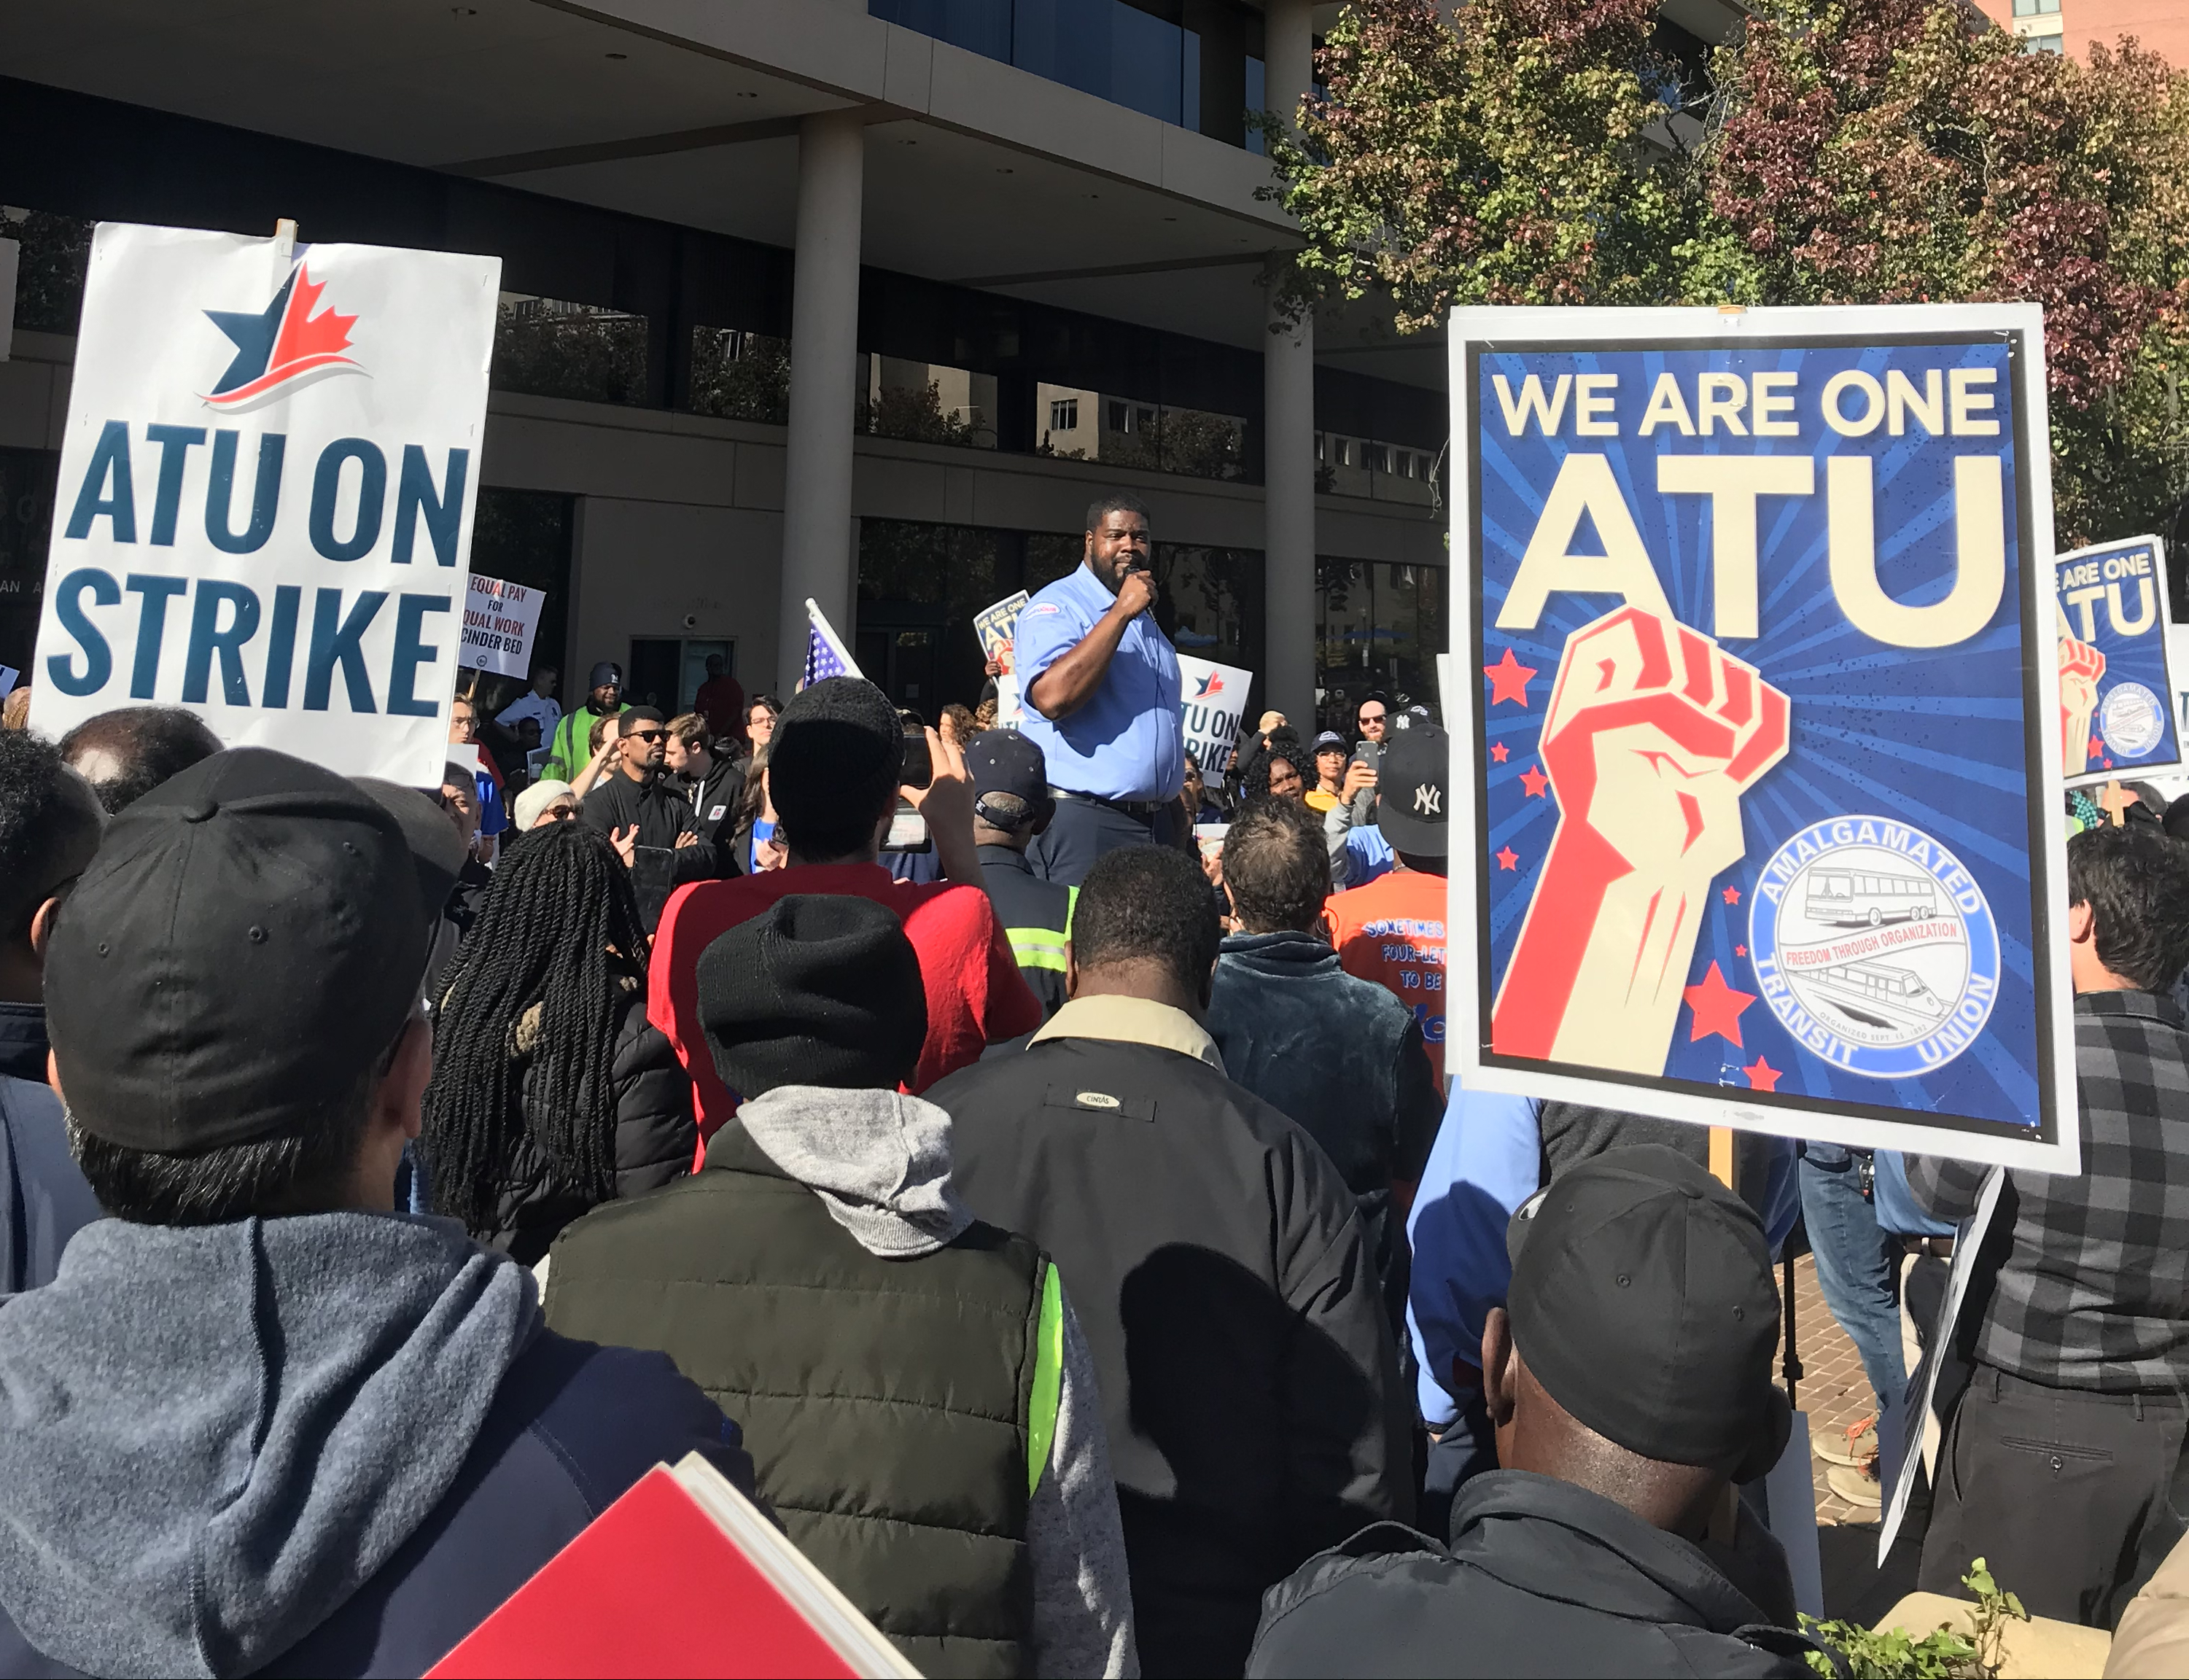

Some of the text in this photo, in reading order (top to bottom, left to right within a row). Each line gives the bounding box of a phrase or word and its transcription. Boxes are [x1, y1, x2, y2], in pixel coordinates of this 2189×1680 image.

[1492, 368, 2001, 438] WE ARE ONE
[64, 419, 470, 567] ATU ON
[1495, 453, 2005, 648] ATU
[0, 580, 20, 593] AN
[2063, 561, 2100, 590] ARE
[2104, 553, 2151, 580] ONE
[470, 576, 527, 602] EQUAL PAY
[487, 599, 503, 612] FOR
[990, 607, 1007, 623] ARE
[1007, 598, 1026, 613] ONE
[463, 609, 525, 637] QUAL WORK
[47, 567, 454, 718] STRIKE
[461, 628, 522, 655] CINDER BED
[1181, 701, 1240, 742] TU ON
[1413, 783, 1442, 814] NY
[1761, 821, 1982, 915] AMALGAMATED
[1365, 919, 1445, 938] SOMETIMES
[1786, 922, 1957, 965] FREEDOM THROUGH ORGANIZATION
[1381, 944, 1446, 964] FOUR-LET
[1400, 971, 1442, 990] TO BE
[1757, 951, 1994, 1065] TRANSIT UNION
[1820, 1011, 1867, 1040] ORGANIZED
